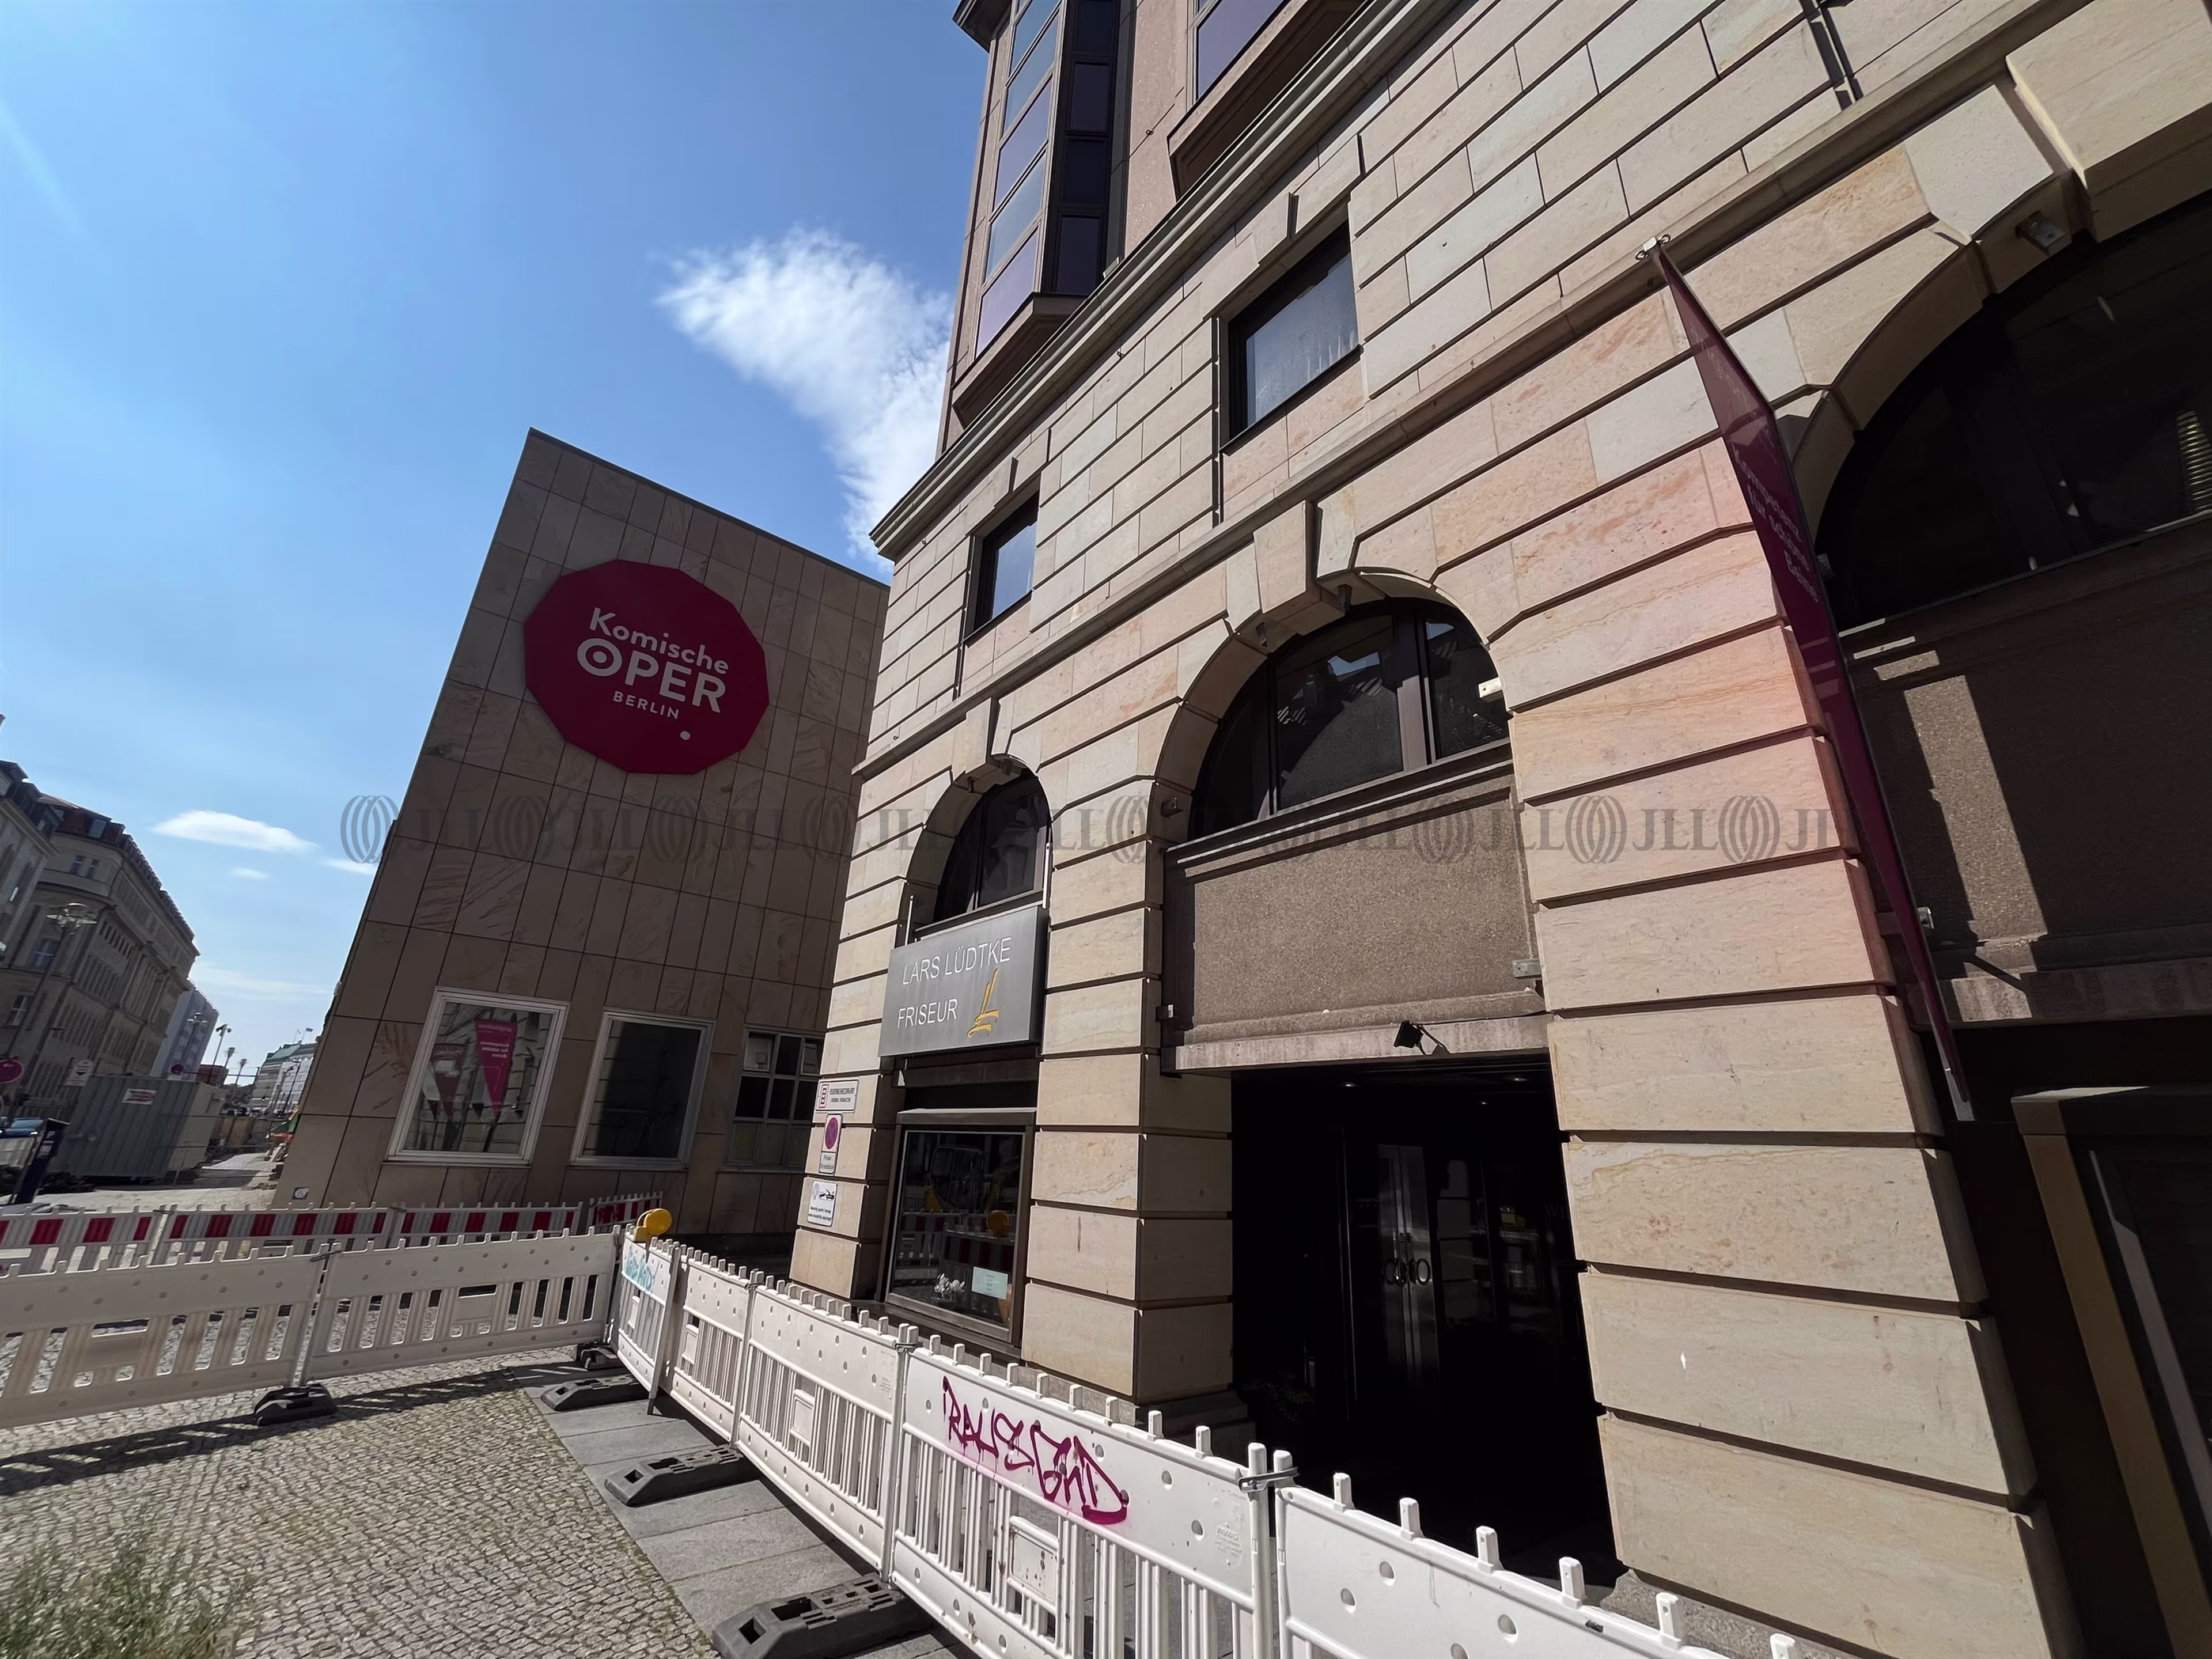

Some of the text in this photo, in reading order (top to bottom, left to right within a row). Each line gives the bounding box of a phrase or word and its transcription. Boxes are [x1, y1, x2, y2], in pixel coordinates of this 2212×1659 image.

[589, 607, 729, 674] Komische
[577, 638, 726, 713] OPER
[612, 690, 680, 719] BERLIN
[902, 937, 1012, 985] LARS LÜDTKE
[897, 998, 958, 1028] FRISEUR
